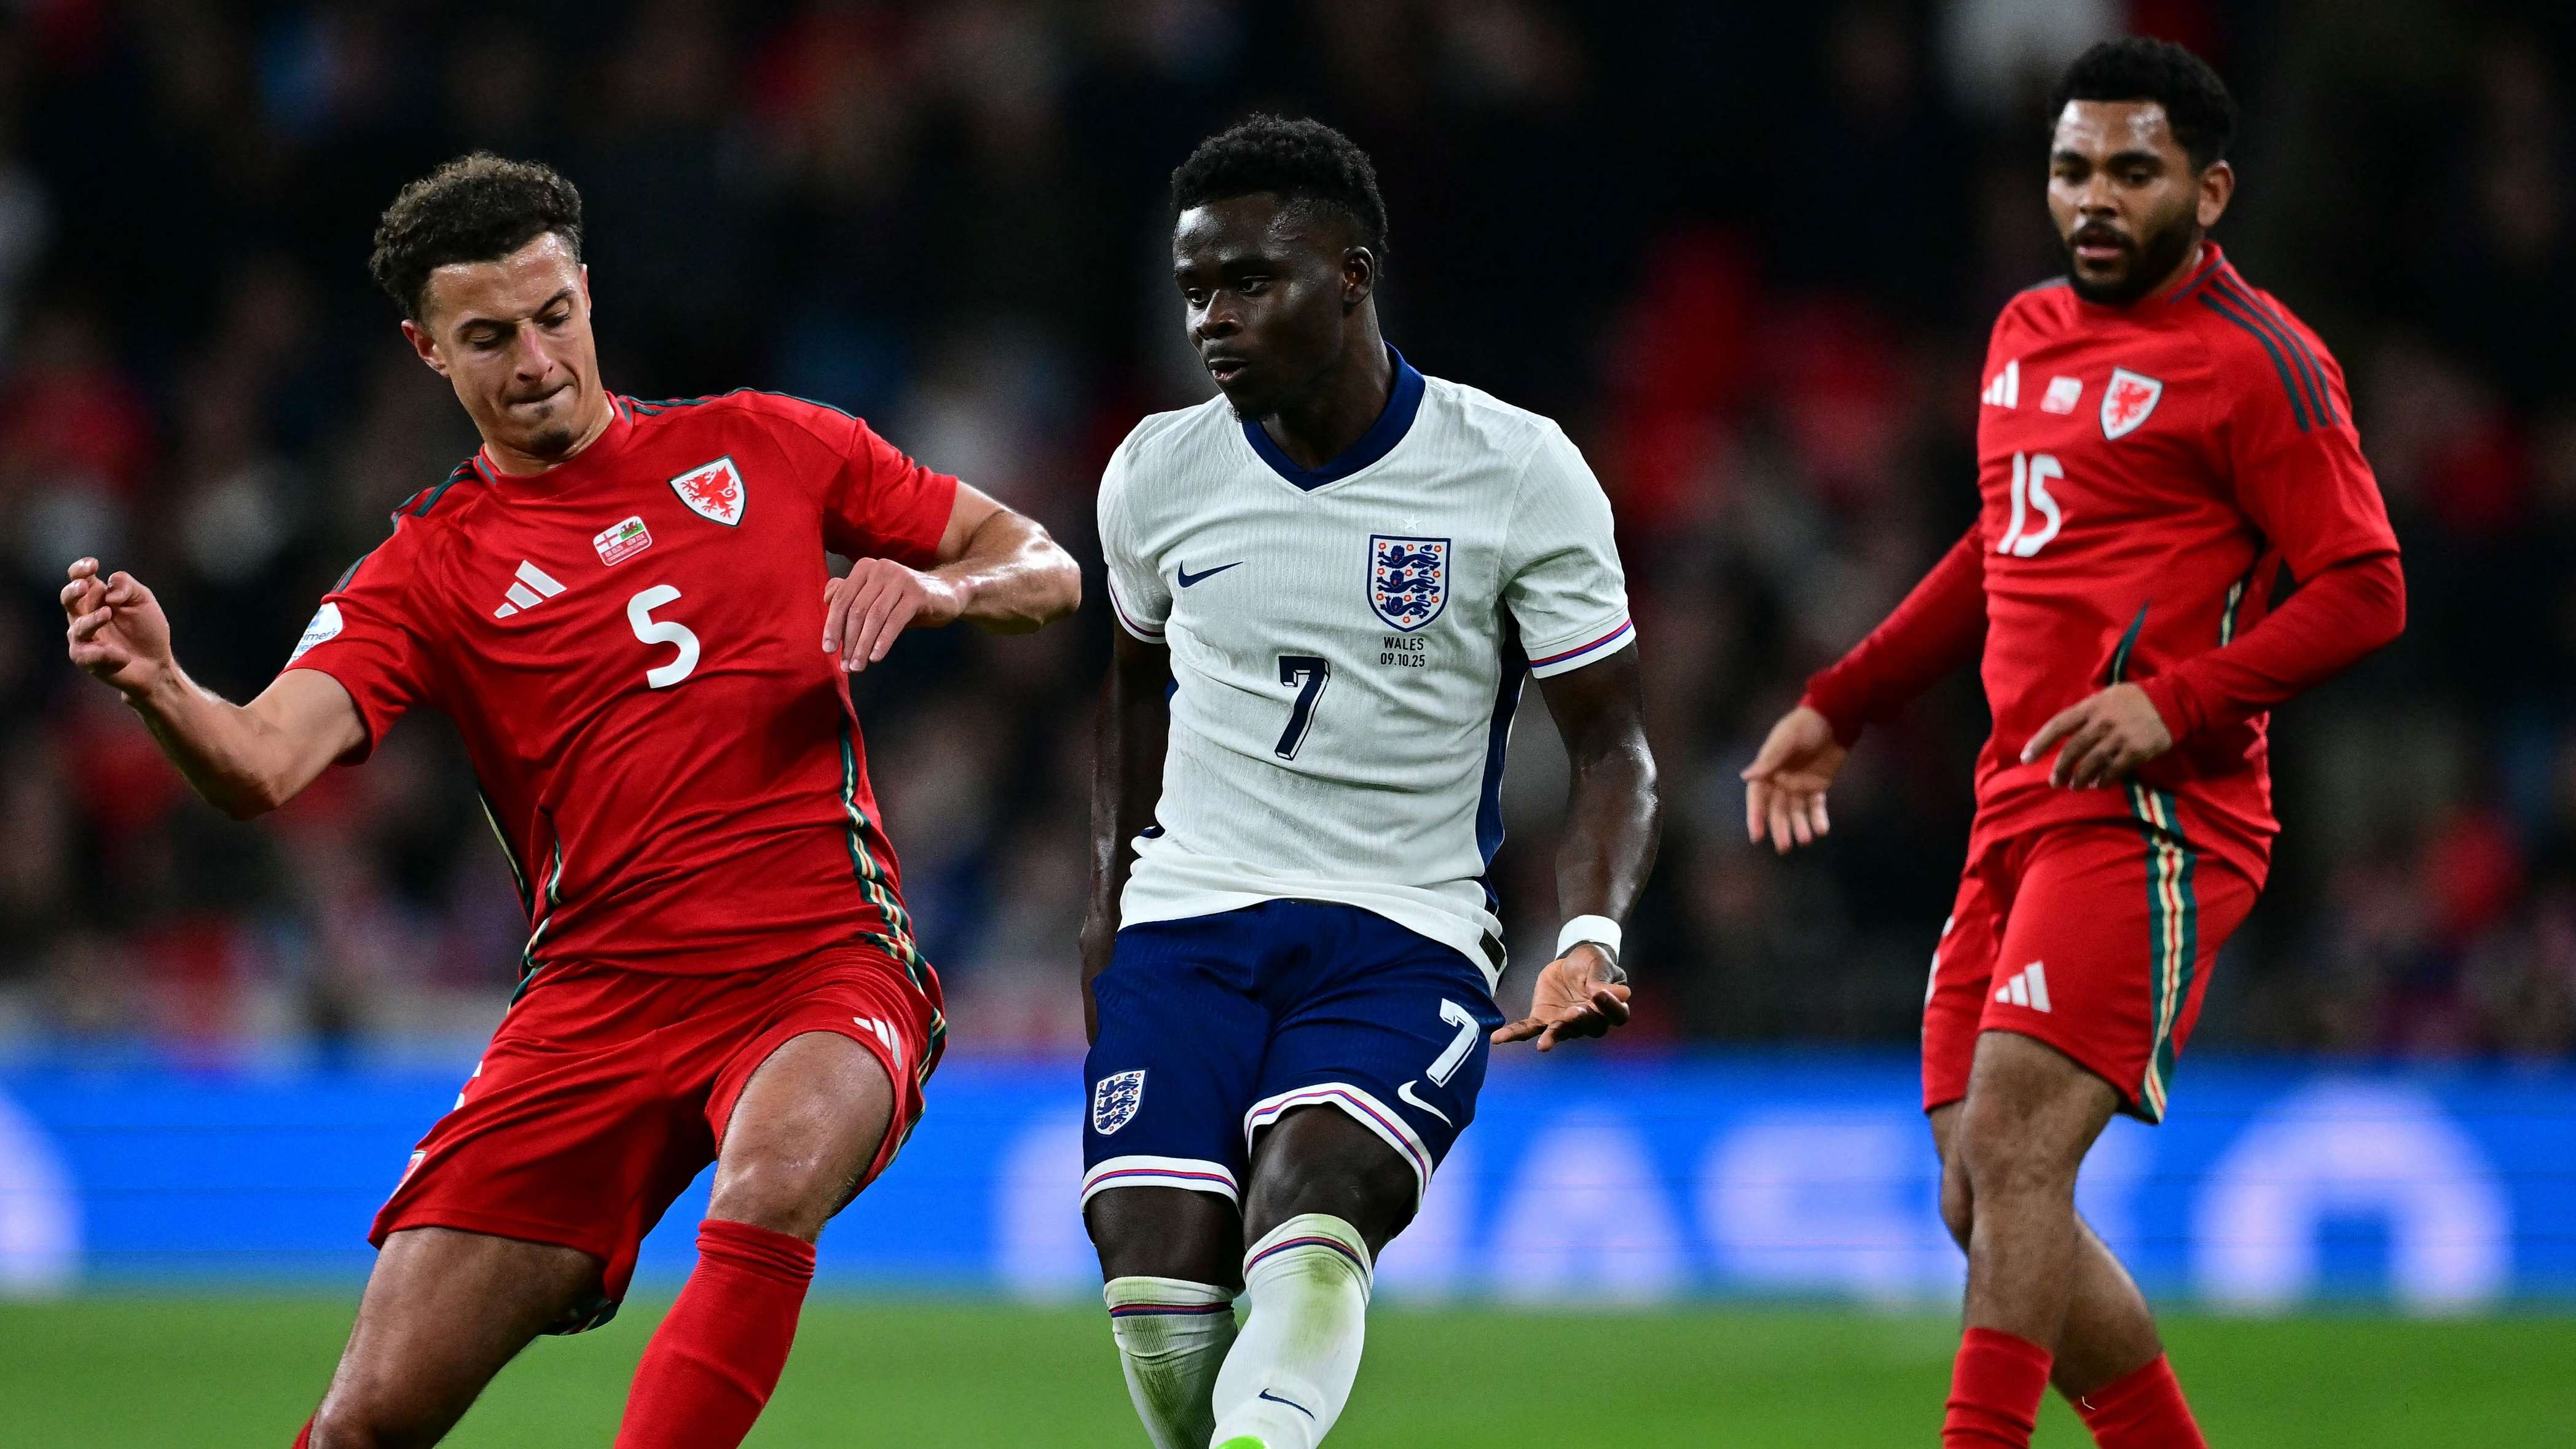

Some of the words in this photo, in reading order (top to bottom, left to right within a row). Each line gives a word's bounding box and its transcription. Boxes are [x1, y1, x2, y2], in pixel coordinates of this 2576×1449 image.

[1997, 450, 2064, 557] 15
[626, 584, 701, 689] 5
[1380, 652, 1426, 667] 09.10.25
[1383, 636, 1424, 651] WALES
[1274, 655, 1331, 761] 7
[1426, 997, 1480, 1088] 7
